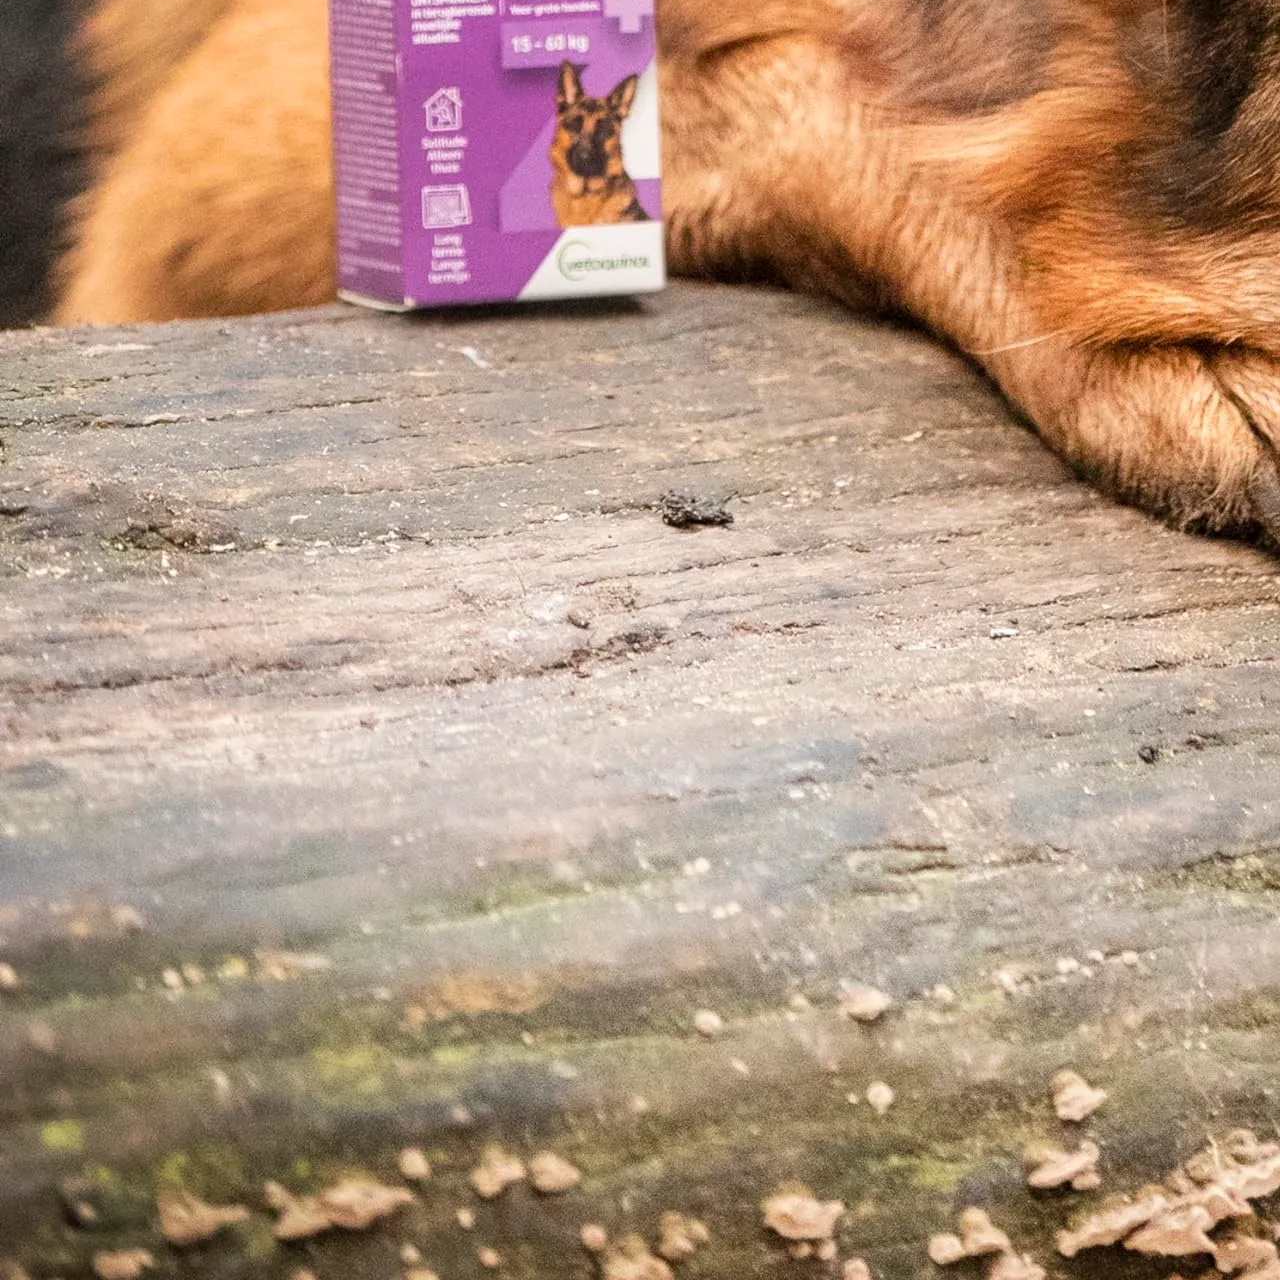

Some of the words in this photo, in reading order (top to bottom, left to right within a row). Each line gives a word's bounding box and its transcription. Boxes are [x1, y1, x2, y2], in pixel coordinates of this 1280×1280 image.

[511, 35, 533, 53] 15
[545, 33, 567, 52] 60
[567, 33, 590, 54] kg
